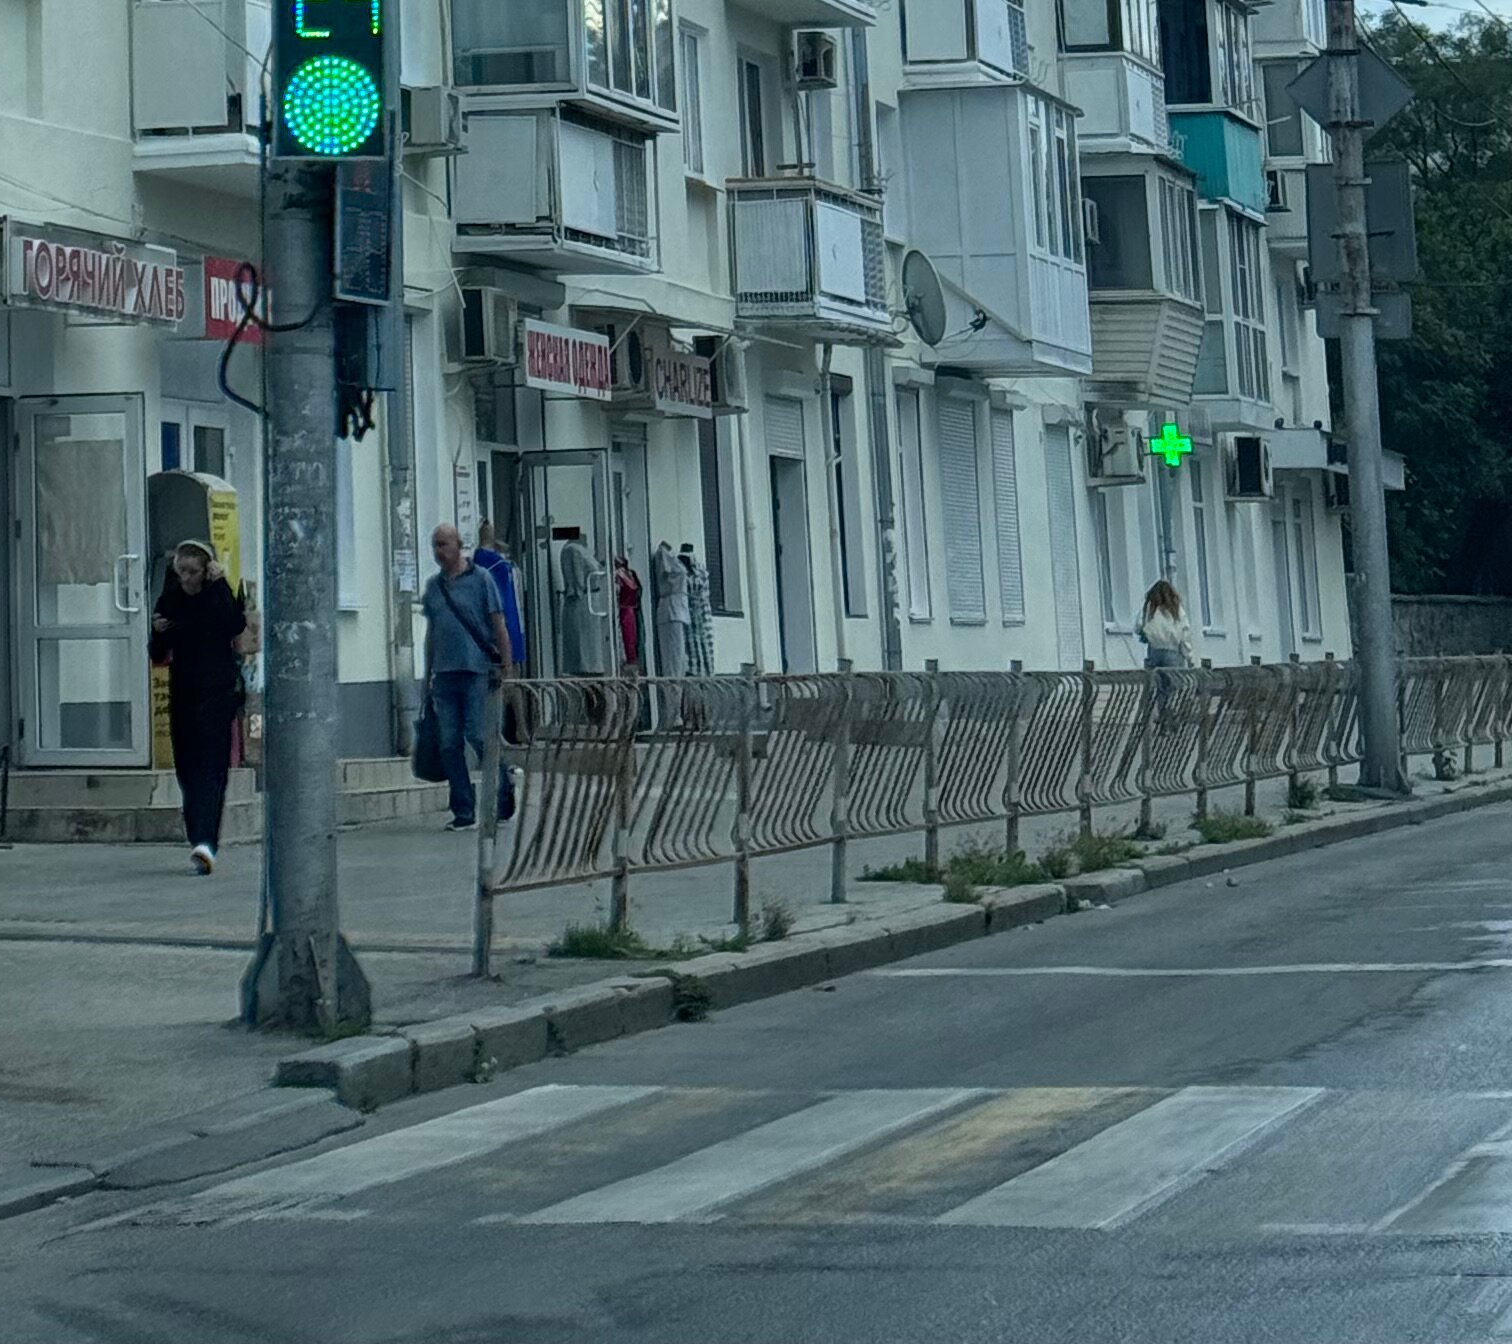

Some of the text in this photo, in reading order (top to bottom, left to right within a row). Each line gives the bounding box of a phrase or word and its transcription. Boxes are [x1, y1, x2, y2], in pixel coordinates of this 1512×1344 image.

[21, 237, 186, 322] ГОРЯЧИЙ ХЛЕБ
[571, 337, 610, 398] ОДЕЖДА
